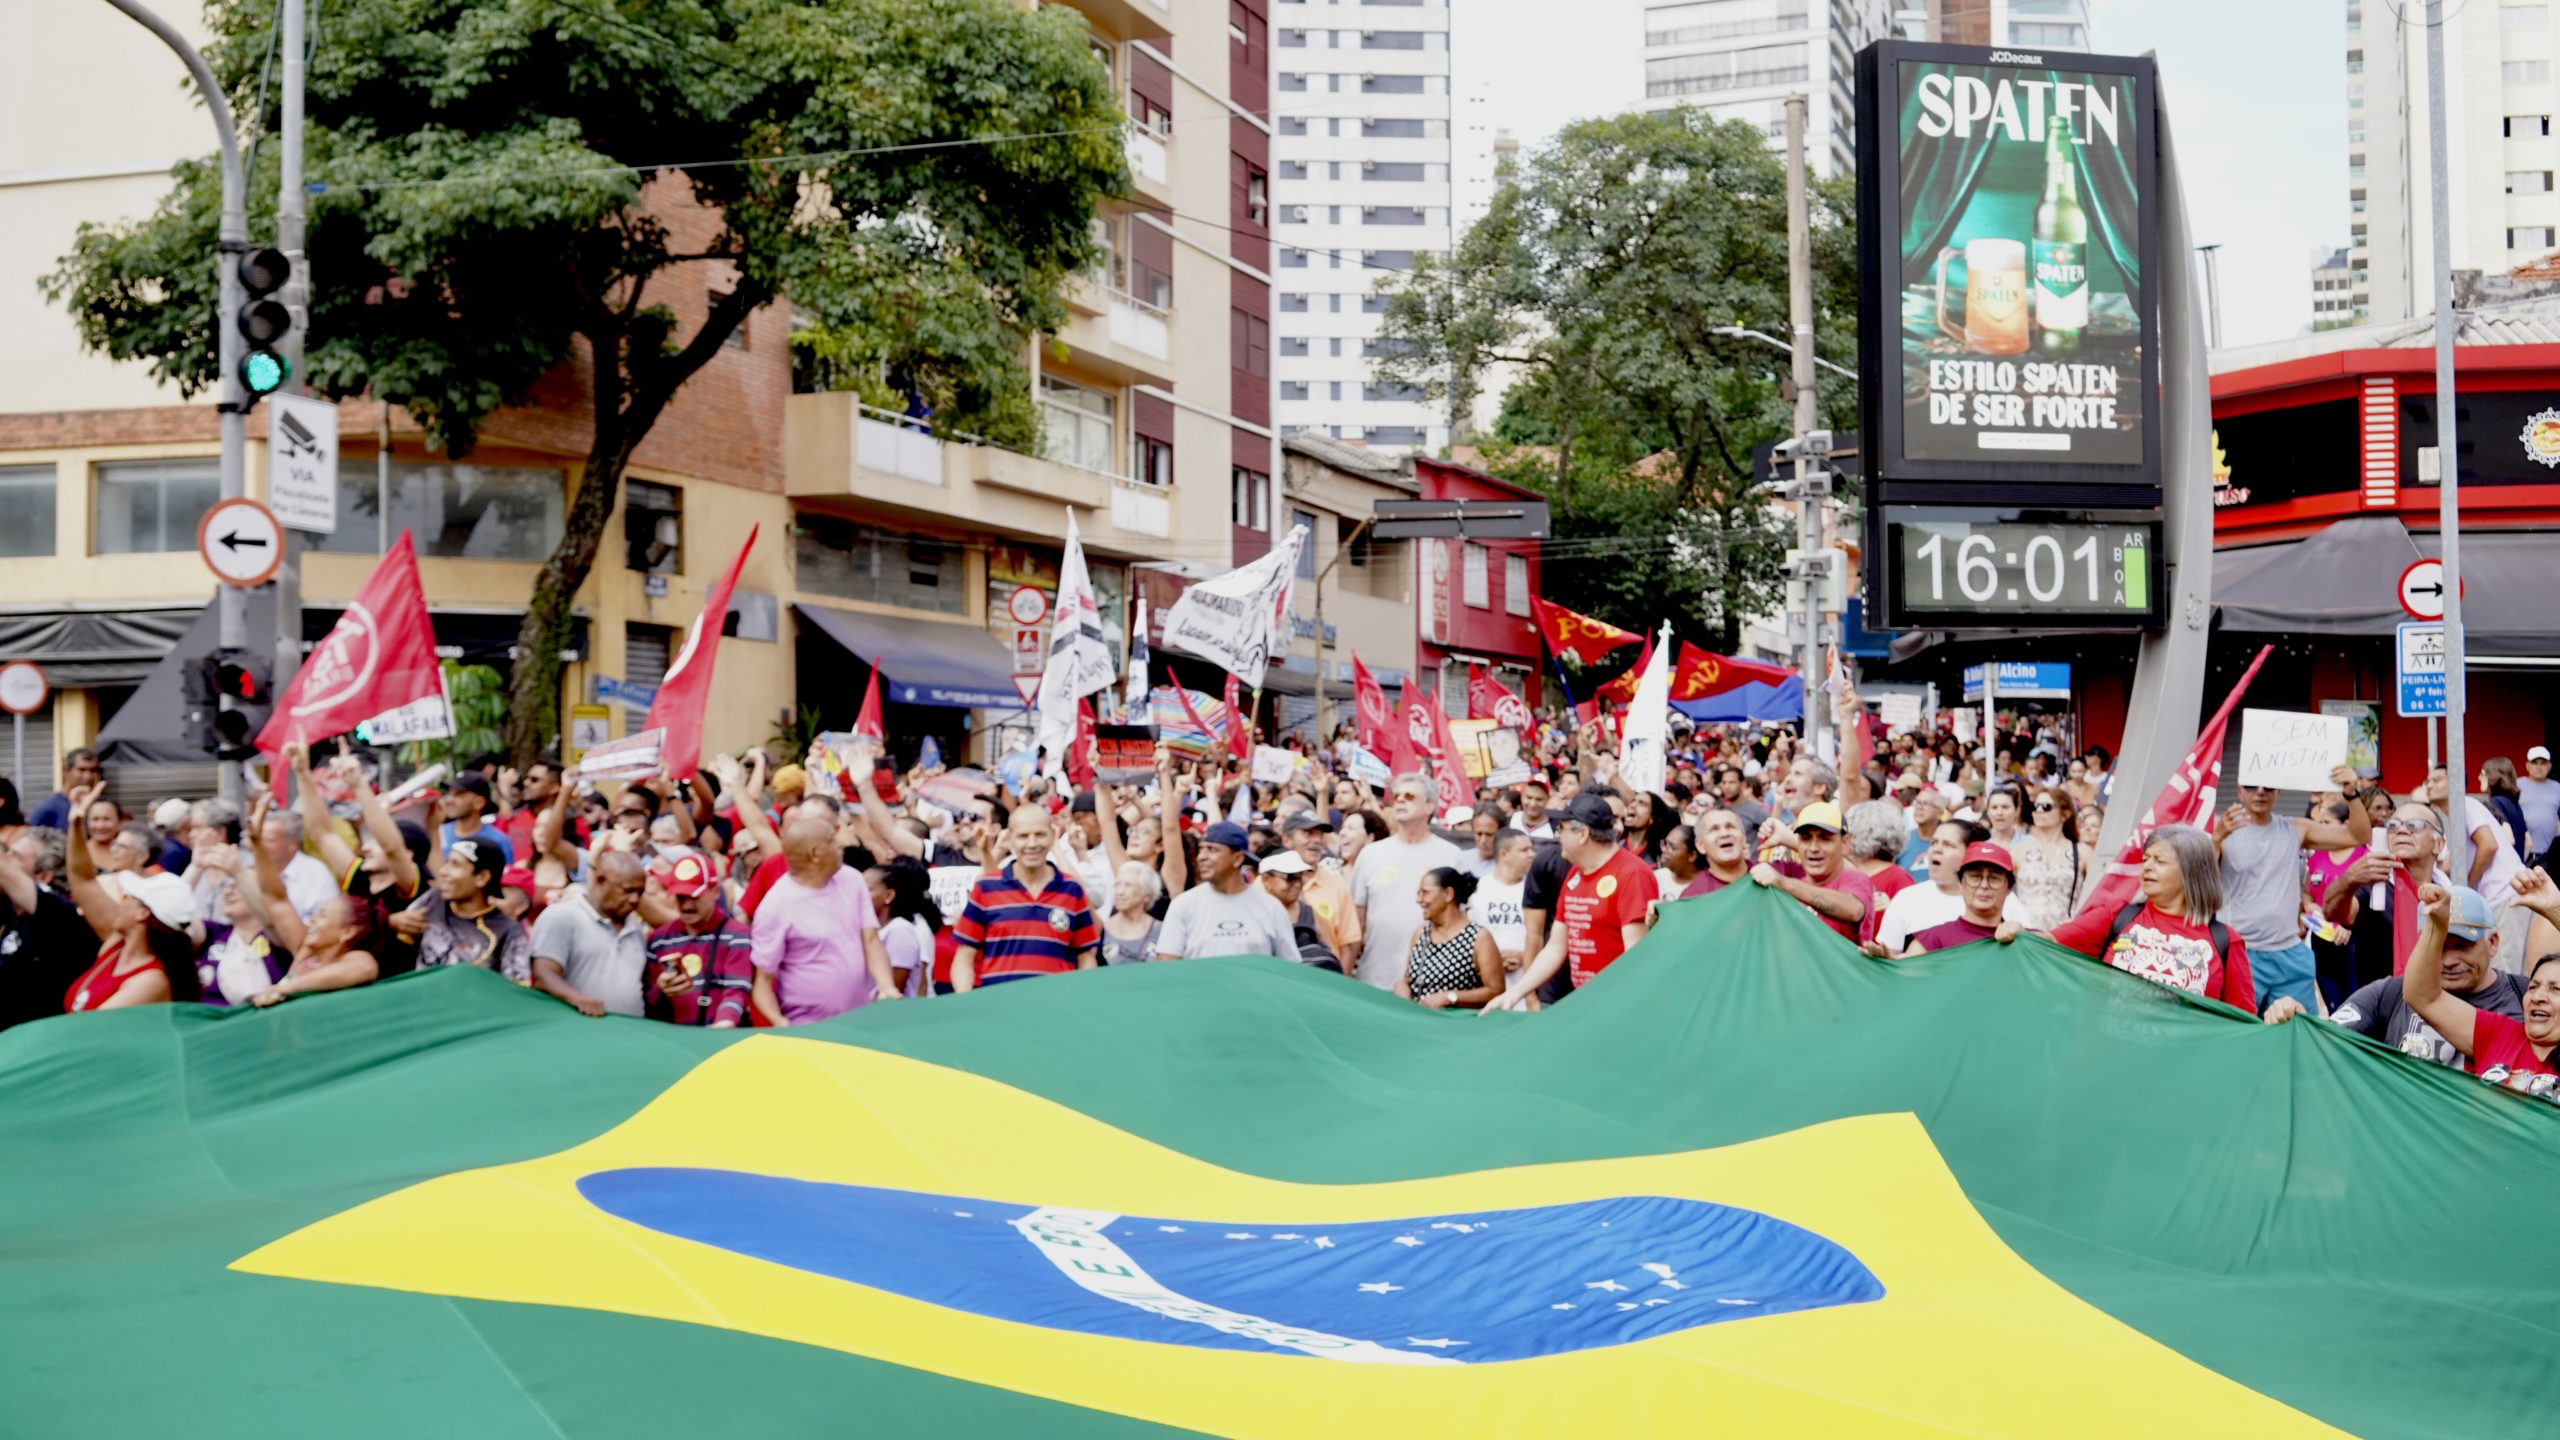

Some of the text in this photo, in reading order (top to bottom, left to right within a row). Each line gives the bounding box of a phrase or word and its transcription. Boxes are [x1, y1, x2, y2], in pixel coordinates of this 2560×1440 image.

[1989, 50, 2043, 65] JCDecaux
[1918, 73, 2118, 147] SPATEN
[2036, 262, 2085, 283] SPATEN
[1929, 359, 2117, 395] ESTILO SPATEN
[1929, 392, 2117, 429] DE SER FORTE
[290, 466, 315, 482] VIA
[2123, 532, 2144, 547] AR
[1917, 534, 2099, 602] 16:01
[2113, 546, 2125, 604] BOA
[2000, 662, 2037, 679] Alcino
[2402, 675, 2446, 686] FEIRA-LIV
[2267, 717, 2328, 746] SEM
[2247, 748, 2330, 772] ANISTIA
[1487, 902, 1520, 913] POL
[1487, 913, 1523, 925] WEA
